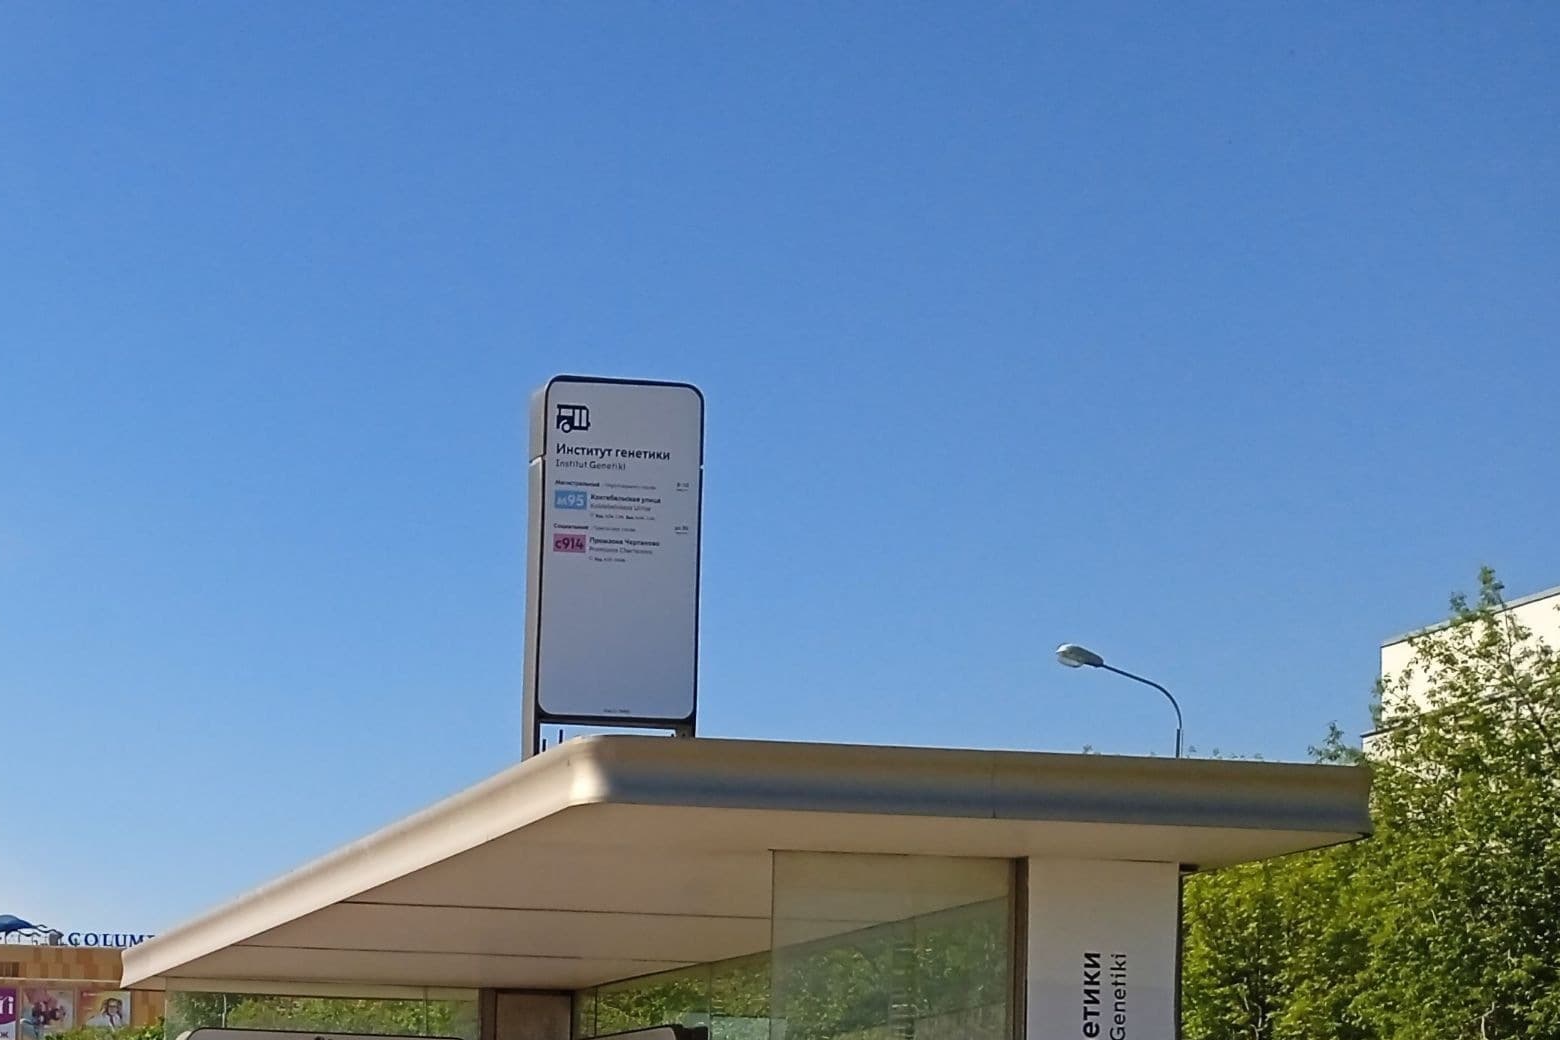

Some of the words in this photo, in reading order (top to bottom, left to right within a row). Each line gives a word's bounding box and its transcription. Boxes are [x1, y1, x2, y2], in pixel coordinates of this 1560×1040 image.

[556, 443, 612, 458] Институт
[615, 448, 670, 461] генетики
[556, 460, 587, 468] Institut
[590, 461, 626, 471] Genetiki
[68, 932, 155, 947] COLUM
